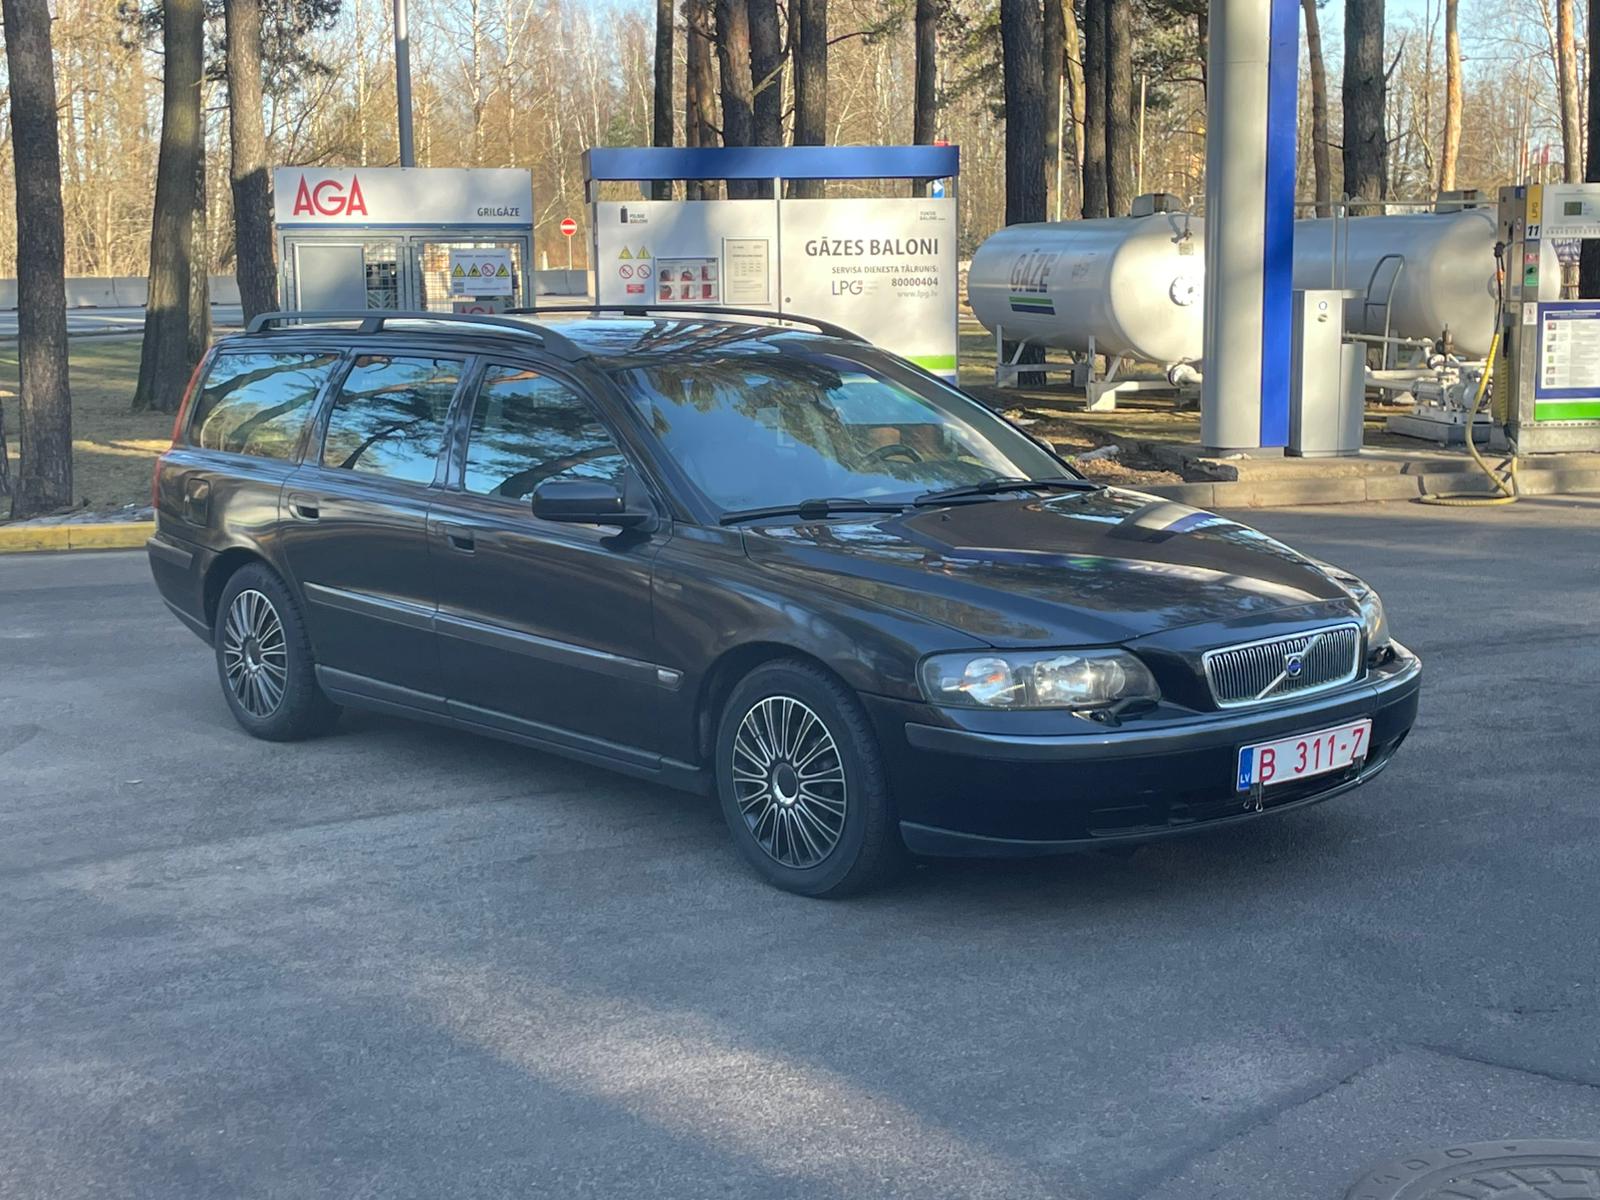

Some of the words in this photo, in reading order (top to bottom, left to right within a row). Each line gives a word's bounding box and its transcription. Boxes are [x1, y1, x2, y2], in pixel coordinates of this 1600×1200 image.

[293, 173, 368, 216] AGA
[1527, 225, 1540, 236] 11
[805, 236, 864, 256] GĀZES
[870, 238, 939, 256] BALONI
[832, 266, 862, 274] SERVISA
[864, 265, 899, 274] DIENESTA
[1010, 248, 1057, 293] GĀZE
[832, 280, 863, 296] LPG
[891, 277, 939, 287] 80000404
[1259, 748, 1276, 783] B
[1240, 773, 1251, 784] LV
